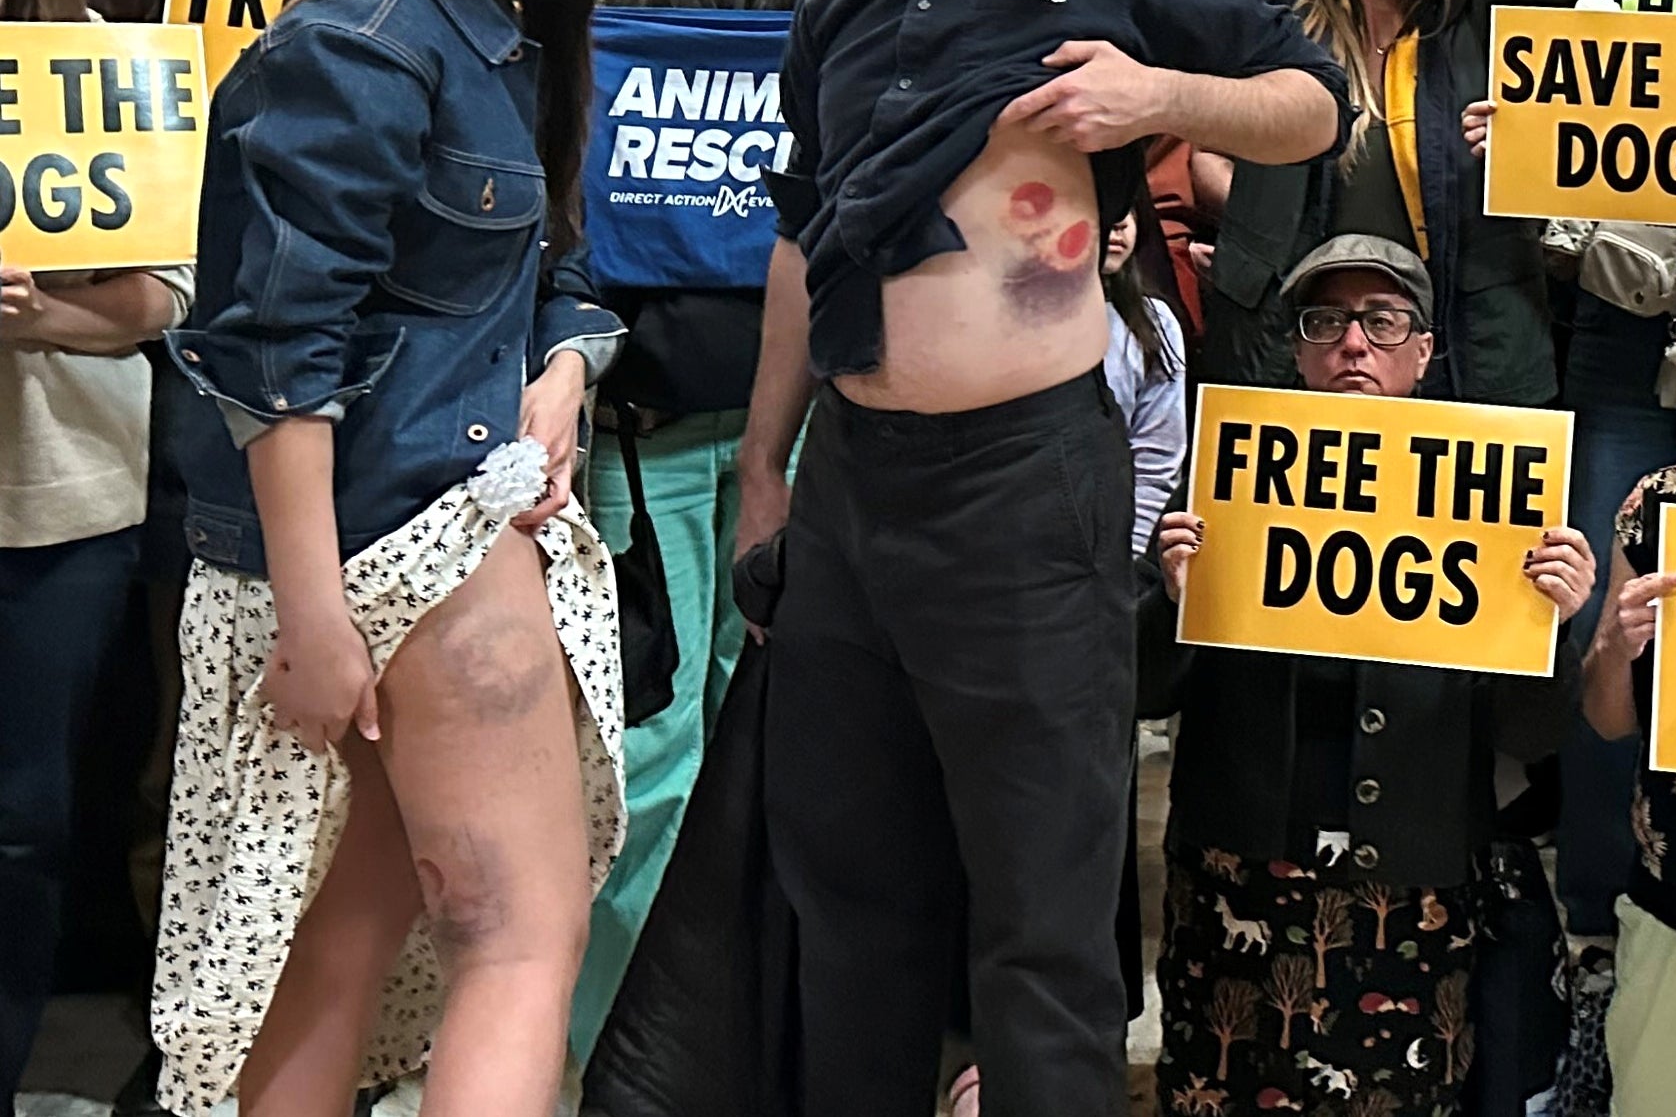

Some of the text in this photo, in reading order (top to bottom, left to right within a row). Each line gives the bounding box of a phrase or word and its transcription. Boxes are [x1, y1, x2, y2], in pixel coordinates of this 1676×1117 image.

[50, 58, 197, 133] THE
[608, 66, 785, 124] ANIM
[1500, 36, 1662, 109] SAVE
[0, 152, 133, 234] GS
[609, 191, 663, 205] DIRECT
[663, 194, 716, 207] ACTION
[1213, 421, 1548, 528] FREE THE
[1262, 526, 1480, 626] DOGS
